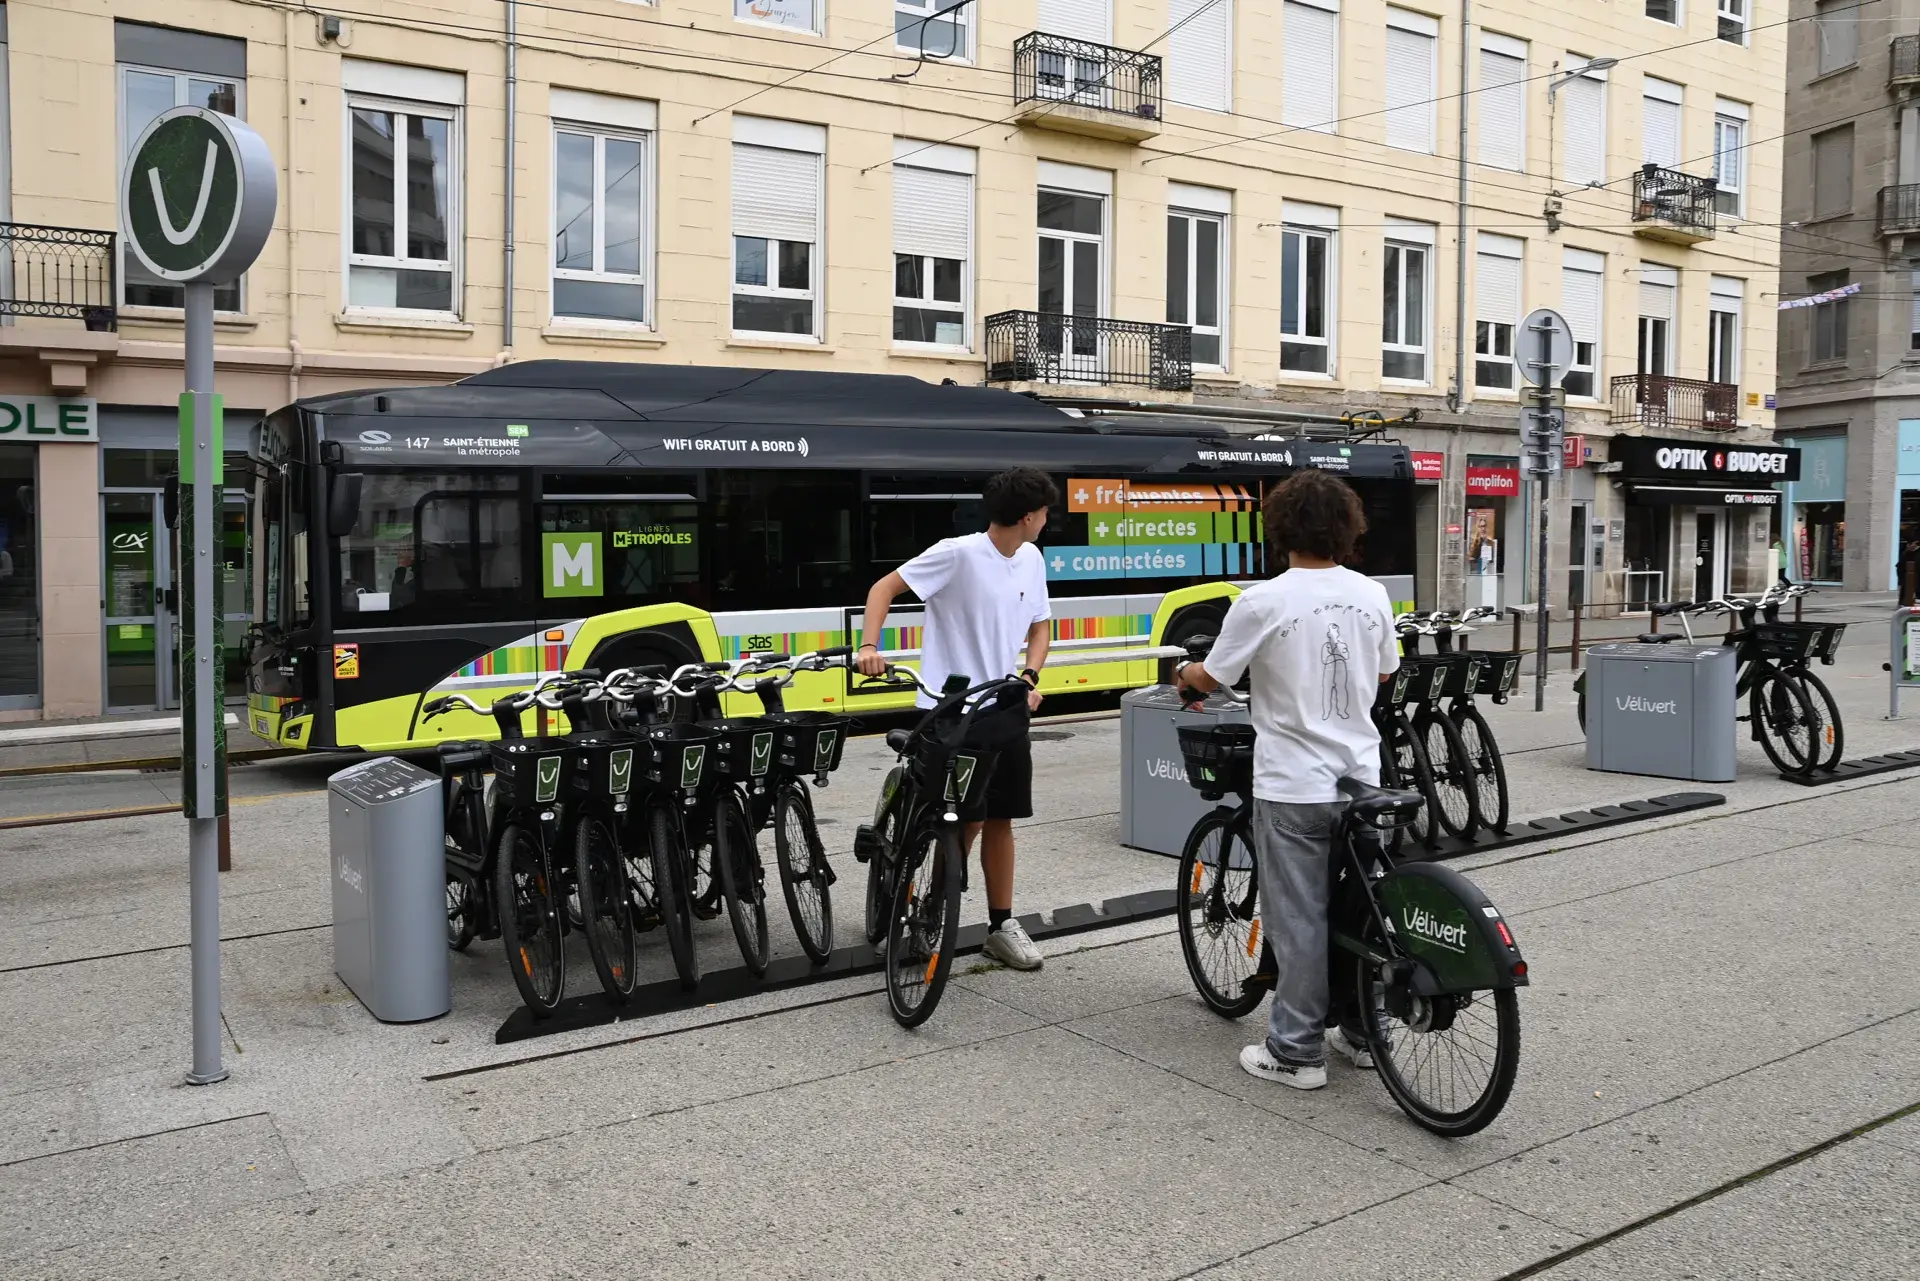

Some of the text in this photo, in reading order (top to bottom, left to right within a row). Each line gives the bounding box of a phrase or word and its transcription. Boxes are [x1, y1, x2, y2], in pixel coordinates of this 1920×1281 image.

[405, 437, 430, 449] 147
[443, 436, 520, 447] SAINT-ÉTIENNE
[663, 438, 795, 452] WIFI GRATUIT A BORD
[457, 447, 521, 457] la métropole
[1197, 450, 1284, 462] WIFI GRATUIT A BORD
[1310, 456, 1349, 464] SAINT-ÉTIENNE
[1656, 447, 1708, 471] OPTIK
[1468, 474, 1514, 491] amplifon
[1096, 484, 1204, 508] fréquentes
[1116, 519, 1197, 537] directes
[614, 531, 692, 547] MÉTROPOLES
[552, 542, 593, 587] M
[1072, 549, 1186, 571] connectées
[747, 634, 772, 650] stas
[1616, 695, 1676, 714] Vélivert
[1403, 907, 1467, 947] Vélivert
